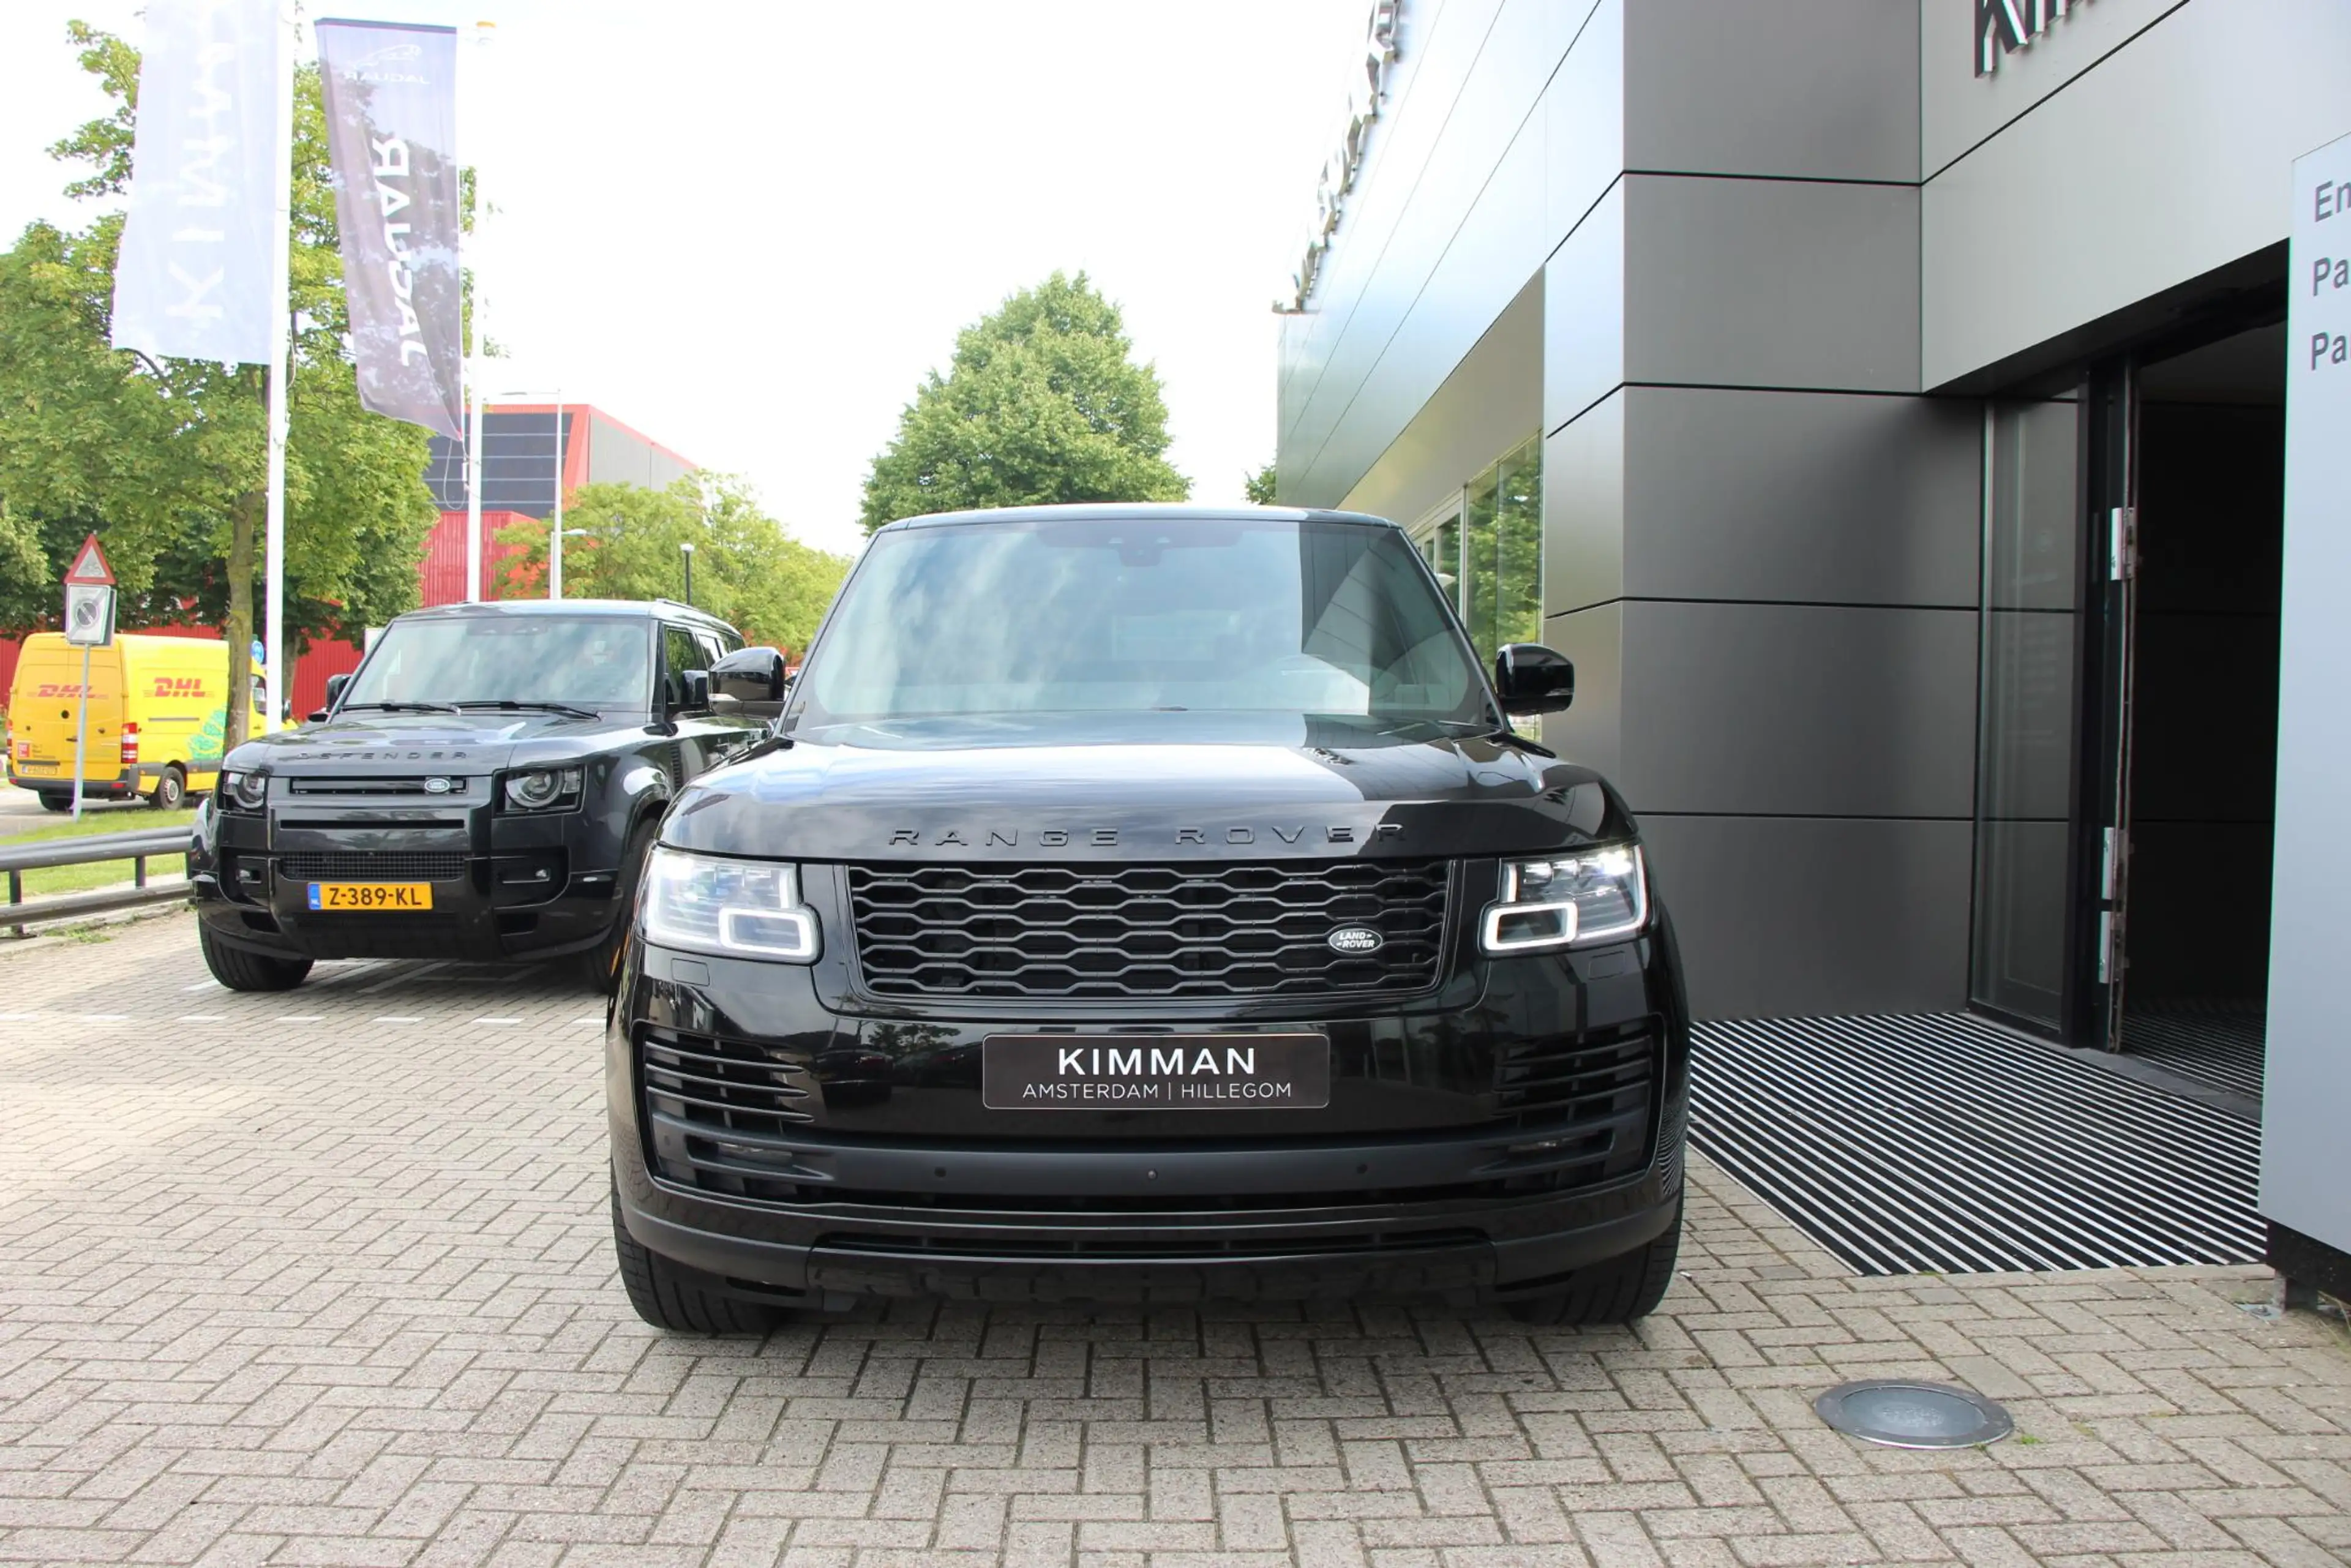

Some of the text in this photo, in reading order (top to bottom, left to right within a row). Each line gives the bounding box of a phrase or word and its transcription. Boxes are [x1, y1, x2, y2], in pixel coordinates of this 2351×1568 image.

[2311, 331, 2351, 371] Pa
[37, 684, 96, 699] DHL
[154, 677, 206, 697] DHL
[296, 751, 467, 760] DEFENDER
[889, 823, 1406, 847] RANGE ROVER
[329, 888, 422, 906] Z-389-KL
[1059, 1048, 1255, 1075] KIMMAN
[1022, 1082, 1291, 1099] AMSTERDAM HILLEGOM
